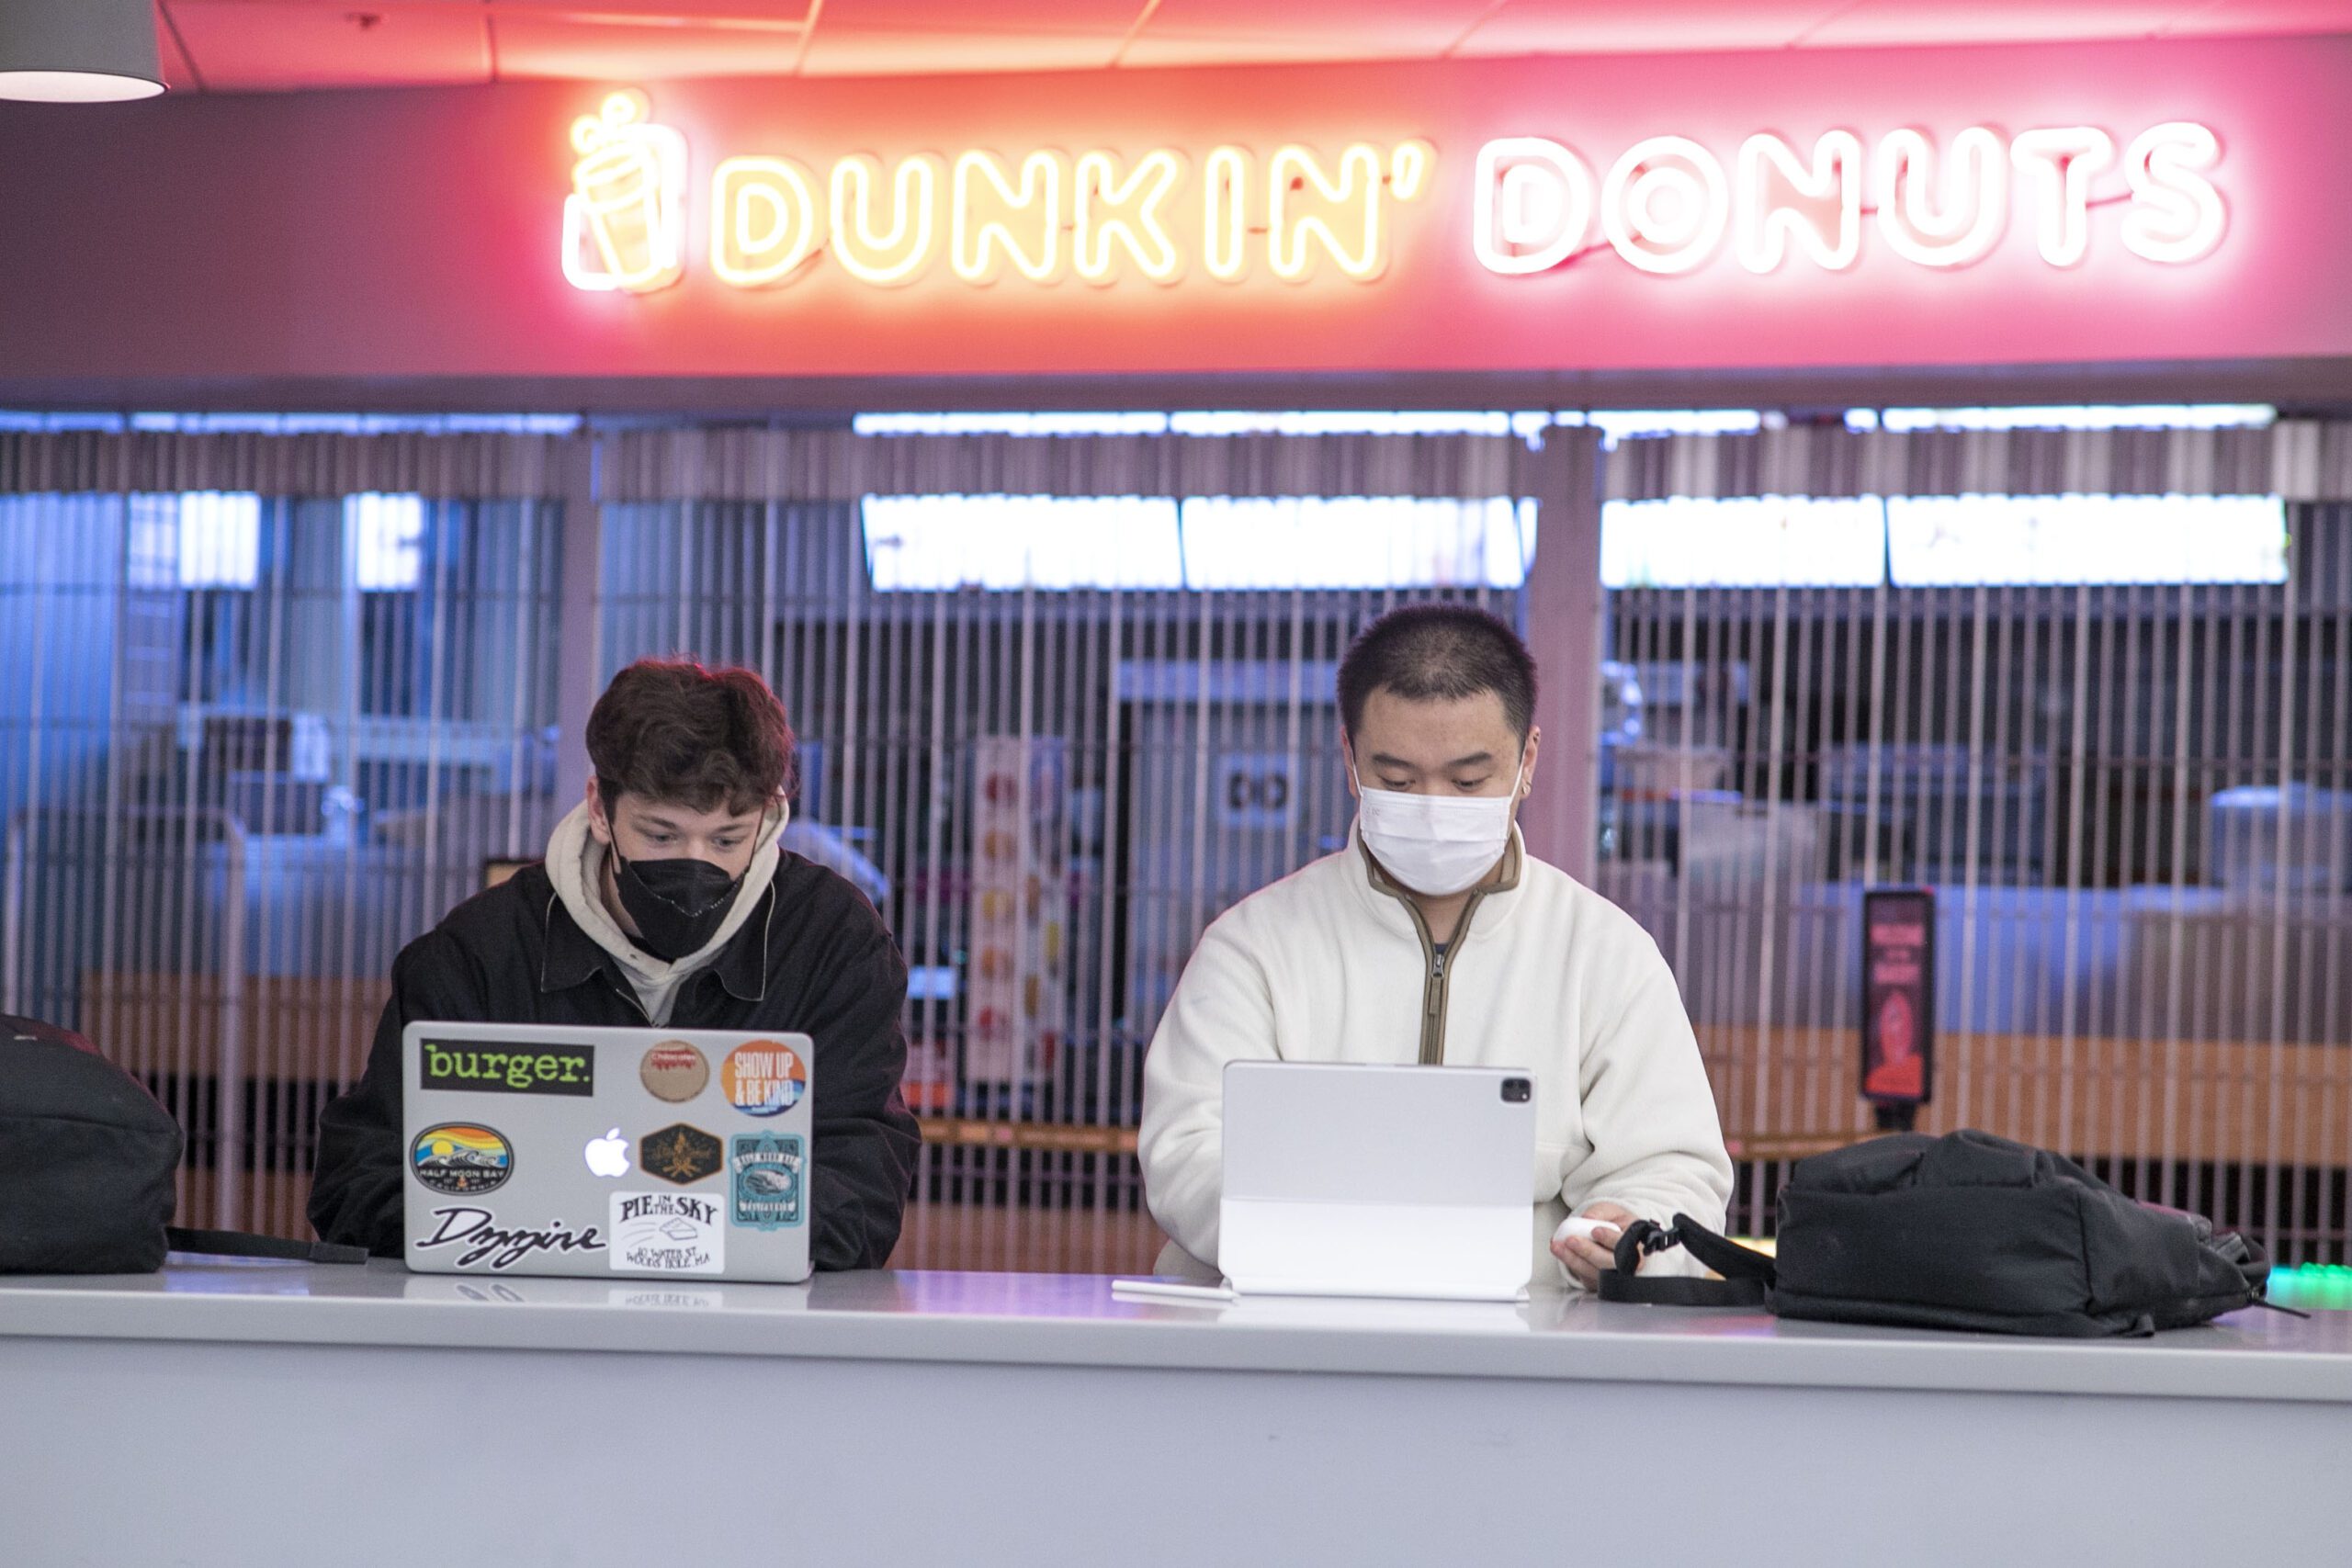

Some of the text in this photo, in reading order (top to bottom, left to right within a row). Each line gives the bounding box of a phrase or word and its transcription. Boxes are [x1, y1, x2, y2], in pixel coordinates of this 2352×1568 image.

[711, 121, 2227, 286] DUNKIN' DONUTS
[424, 1043, 590, 1089] burger.
[735, 1051, 794, 1078] SHOW UP
[735, 1078, 794, 1107] & BE KIND
[420, 1168, 505, 1178] HALF MOON BAY
[618, 1194, 718, 1225] PIE IN SKY
[653, 1203, 675, 1216] THE
